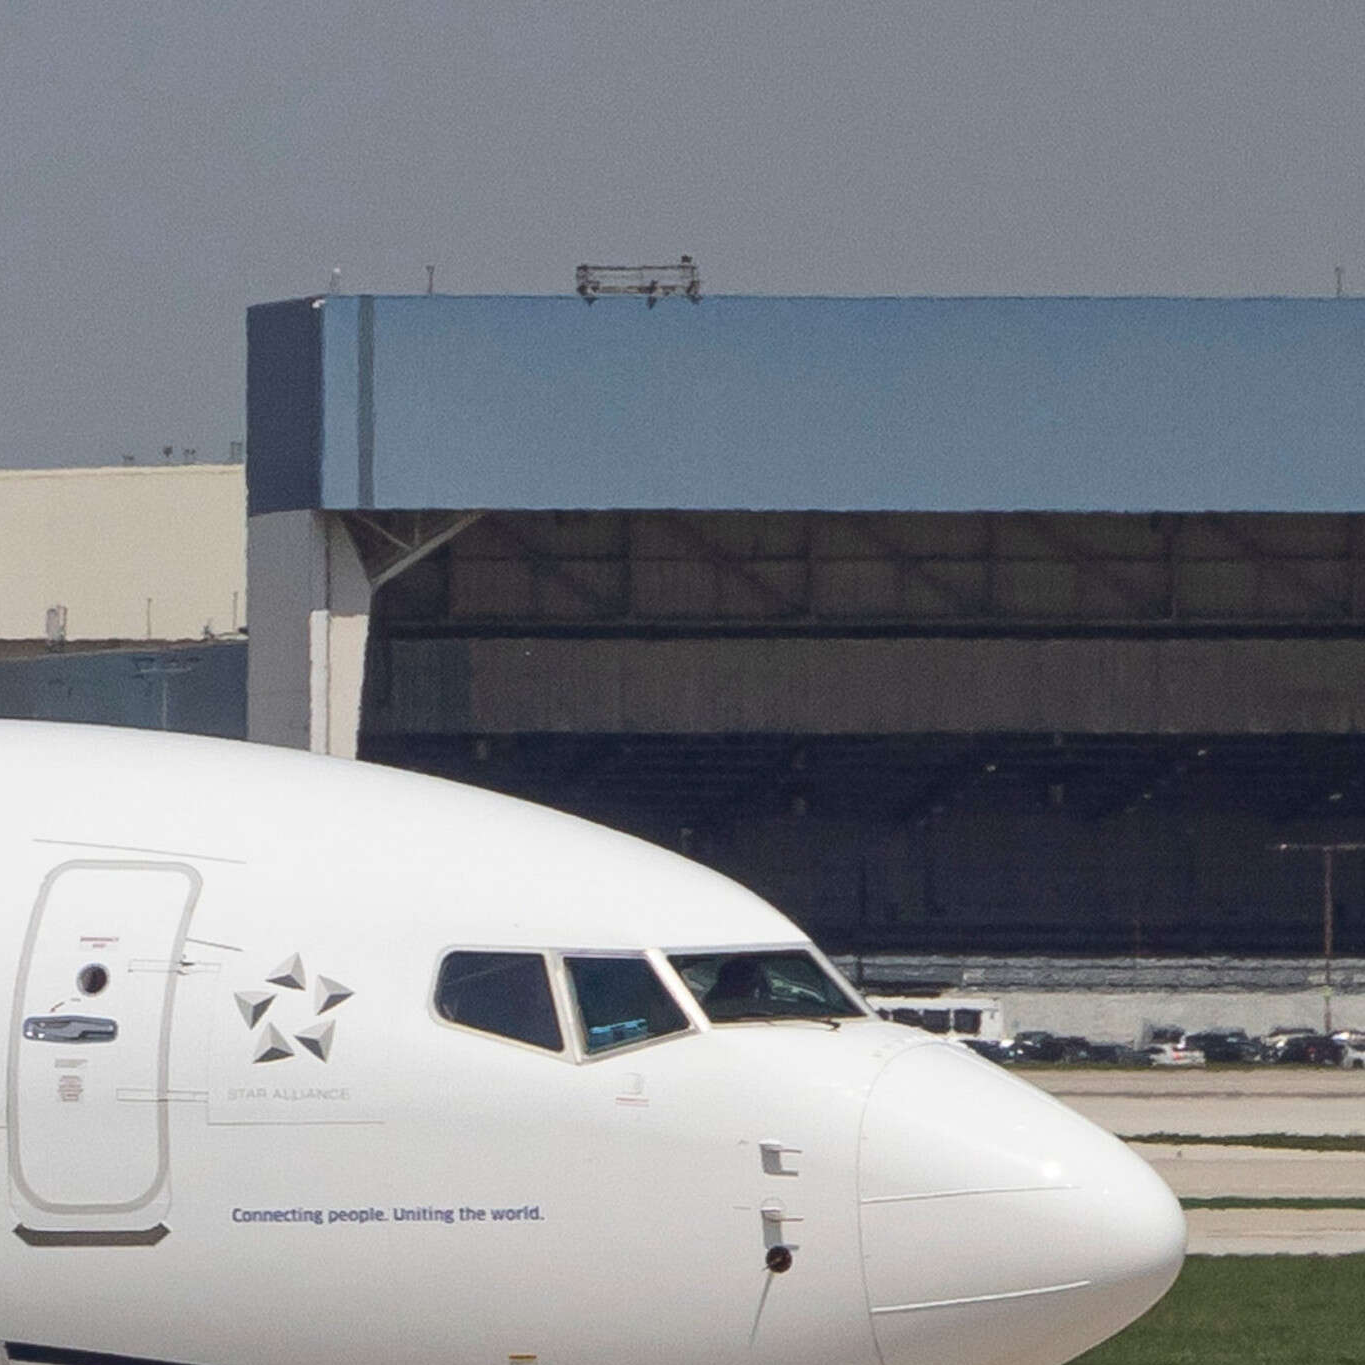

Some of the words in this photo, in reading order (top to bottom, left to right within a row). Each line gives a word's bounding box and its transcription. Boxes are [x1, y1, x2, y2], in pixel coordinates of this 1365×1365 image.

[231, 1207, 323, 1224] Connecting
[327, 1207, 388, 1224] people.
[393, 1206, 455, 1224] Uniting
[459, 1206, 486, 1221] the
[491, 1205, 545, 1221] world.
